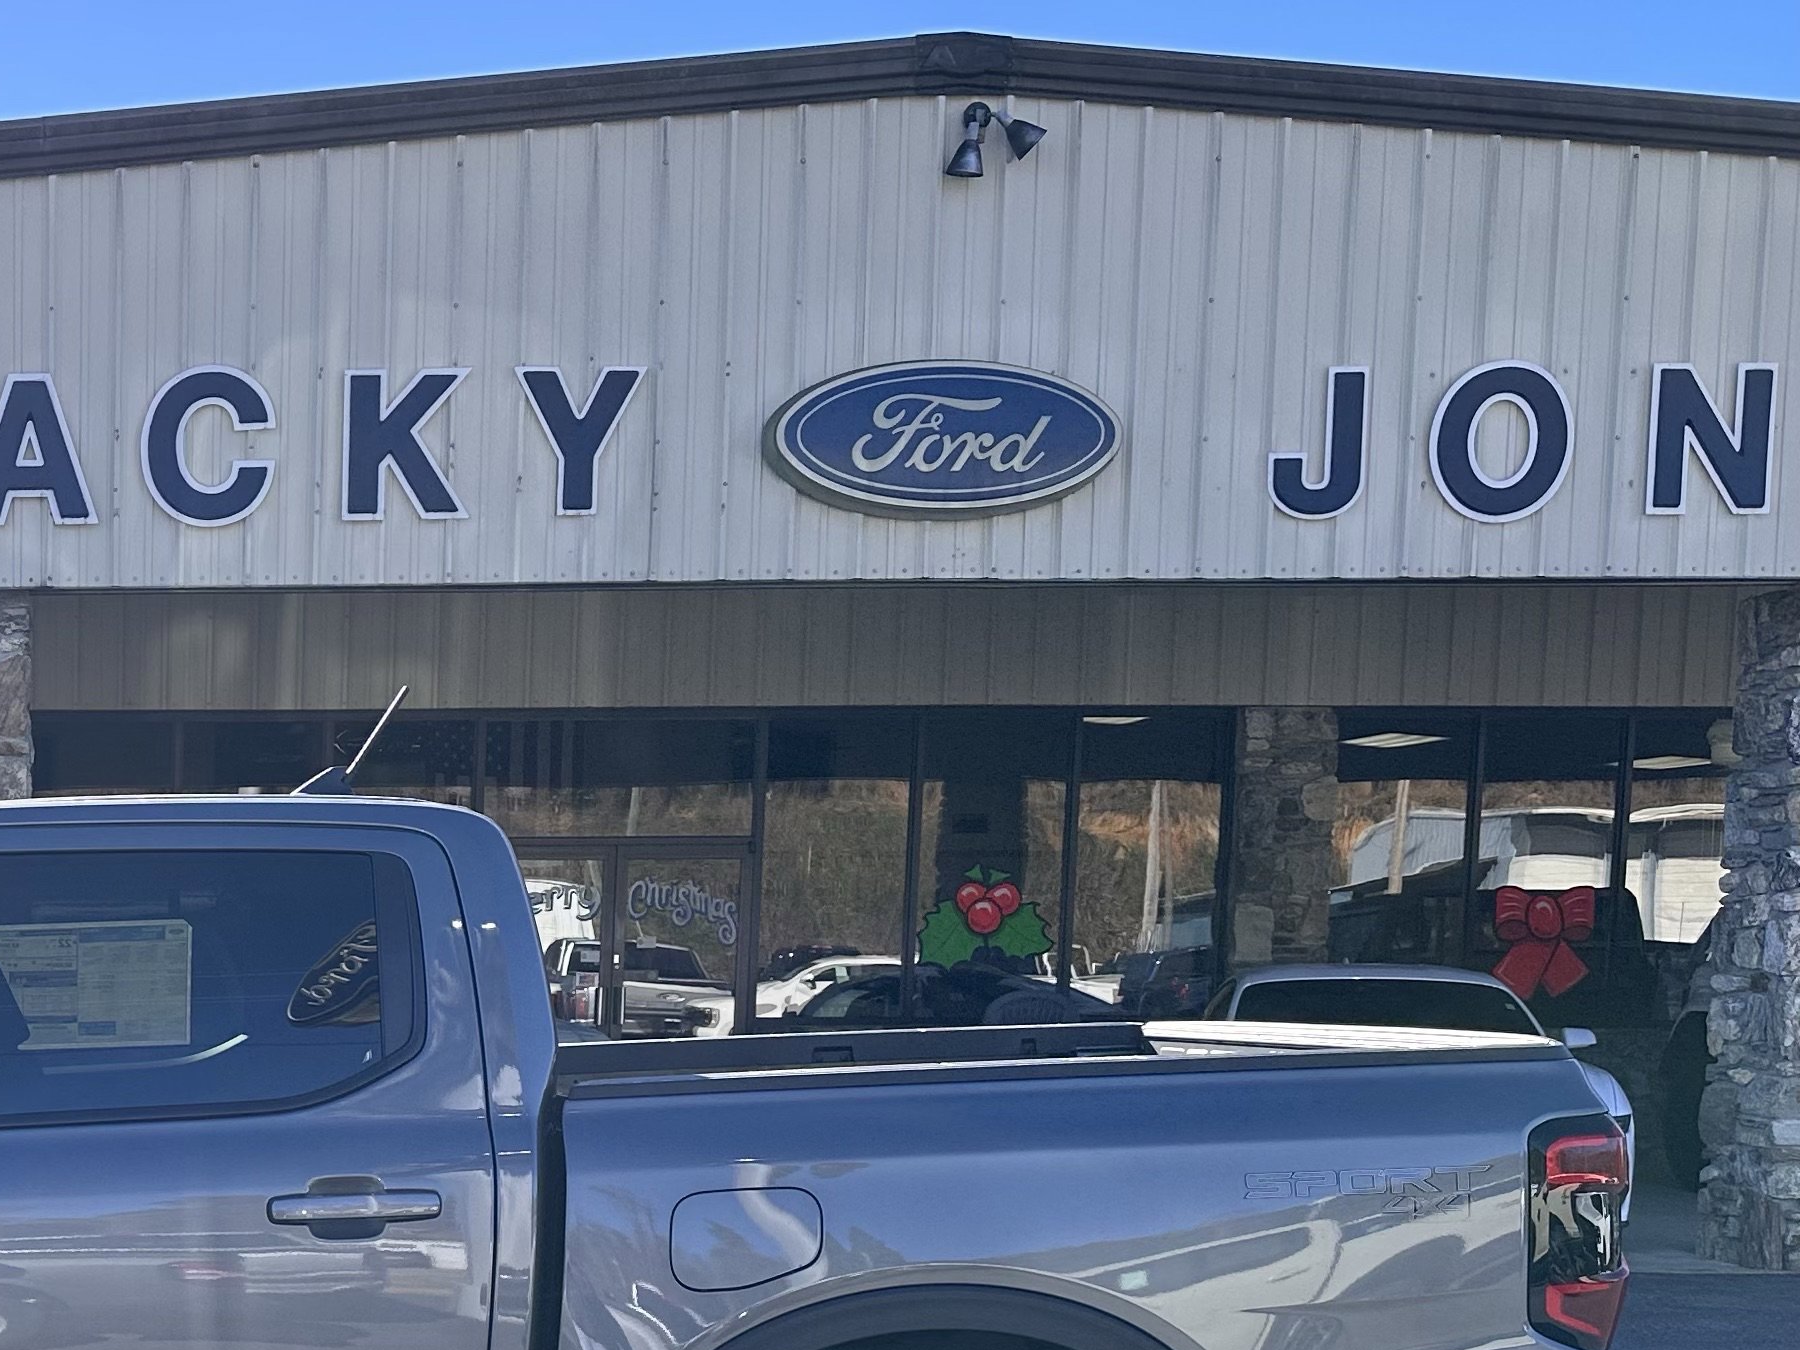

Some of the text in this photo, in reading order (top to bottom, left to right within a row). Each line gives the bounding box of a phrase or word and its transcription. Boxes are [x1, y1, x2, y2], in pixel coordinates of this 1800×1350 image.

[850, 393, 1052, 474] Ford
[1266, 358, 1779, 524] JON
[528, 885, 601, 921] erry
[628, 876, 738, 945] Christmas
[1244, 1164, 1493, 1199] SPORT
